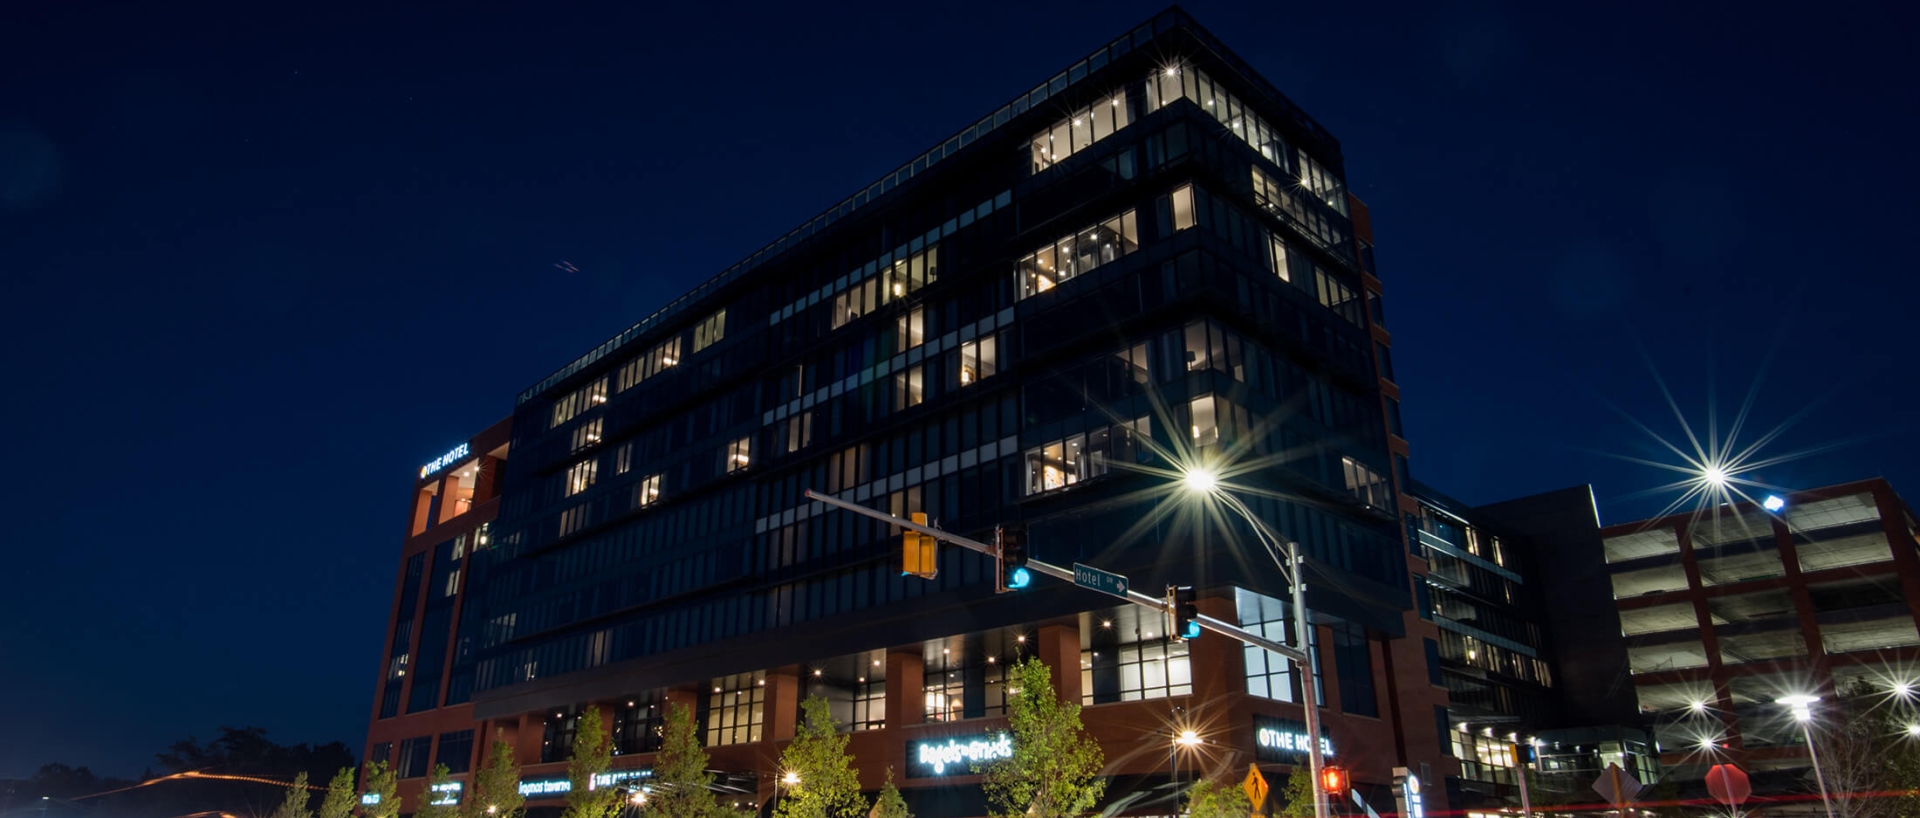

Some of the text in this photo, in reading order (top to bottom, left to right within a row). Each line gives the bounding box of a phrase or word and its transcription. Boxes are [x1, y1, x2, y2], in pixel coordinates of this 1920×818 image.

[427, 443, 469, 475] THE HOTEL
[1075, 568, 1101, 587] Hotel
[920, 739, 961, 774] Bagels
[1269, 730, 1334, 755] THE HOEL
